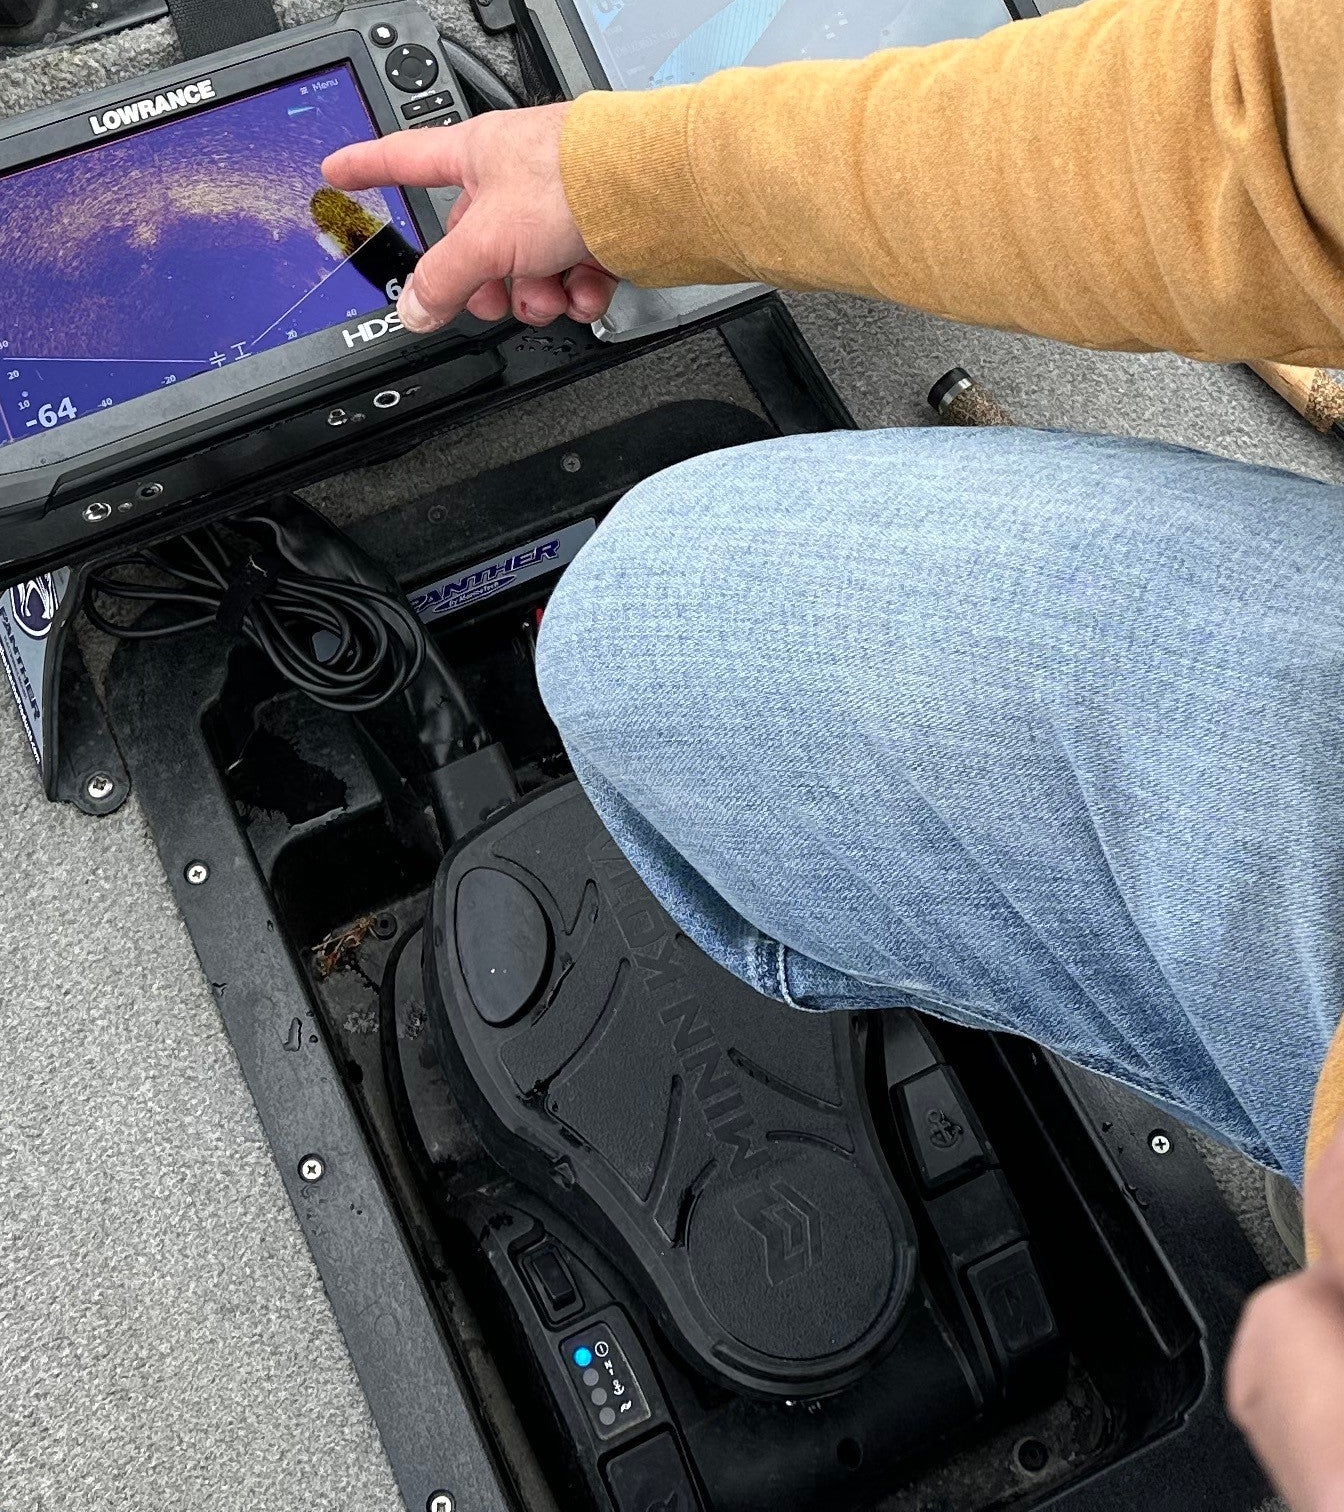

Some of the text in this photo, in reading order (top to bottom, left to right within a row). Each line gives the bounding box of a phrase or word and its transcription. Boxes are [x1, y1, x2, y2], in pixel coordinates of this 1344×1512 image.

[312, 78, 339, 92] Menu
[89, 79, 216, 135] LOWRANCE
[7, 369, 20, 381] 20
[18, 399, 31, 411] 10
[26, 396, 78, 428] -64
[657, 993, 773, 1180] MINN
